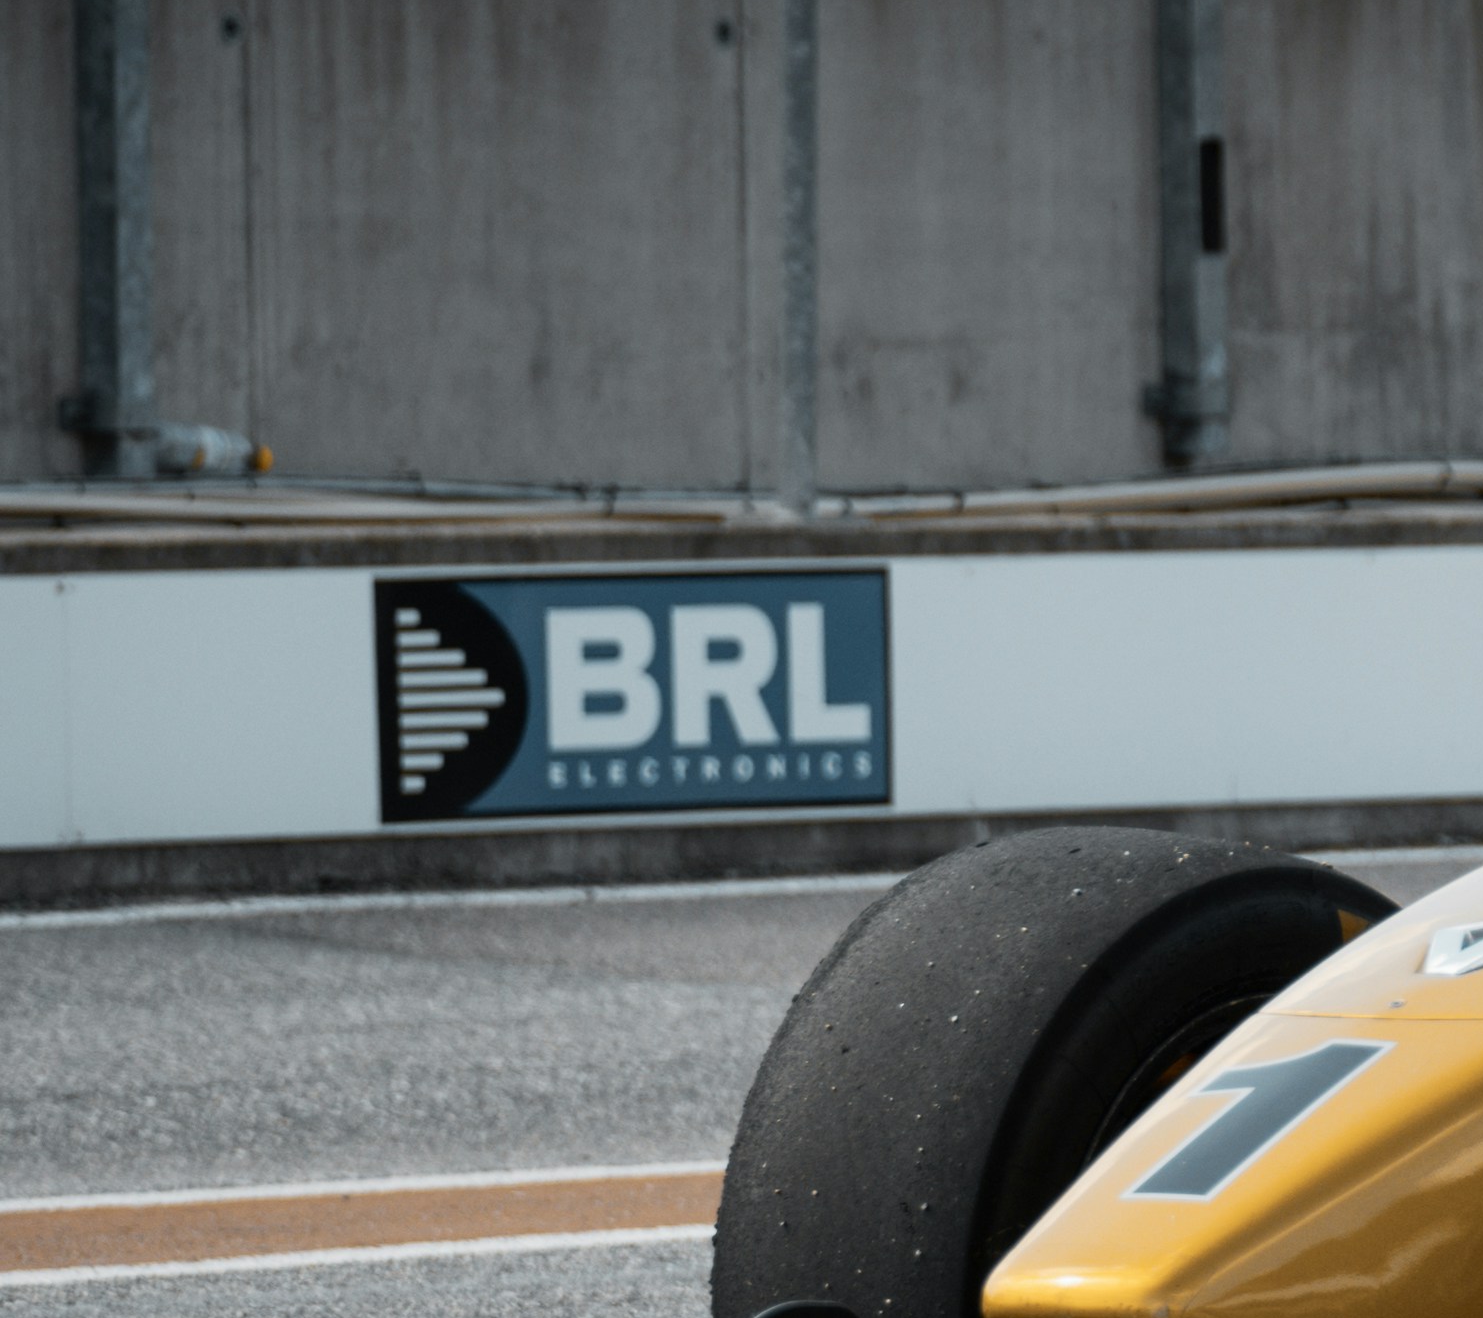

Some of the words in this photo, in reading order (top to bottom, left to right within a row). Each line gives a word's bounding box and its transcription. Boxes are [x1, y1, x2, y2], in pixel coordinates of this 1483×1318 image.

[545, 602, 872, 752] BRL
[548, 750, 873, 789] ELECTRONICS
[1118, 1039, 1398, 1201] 1
